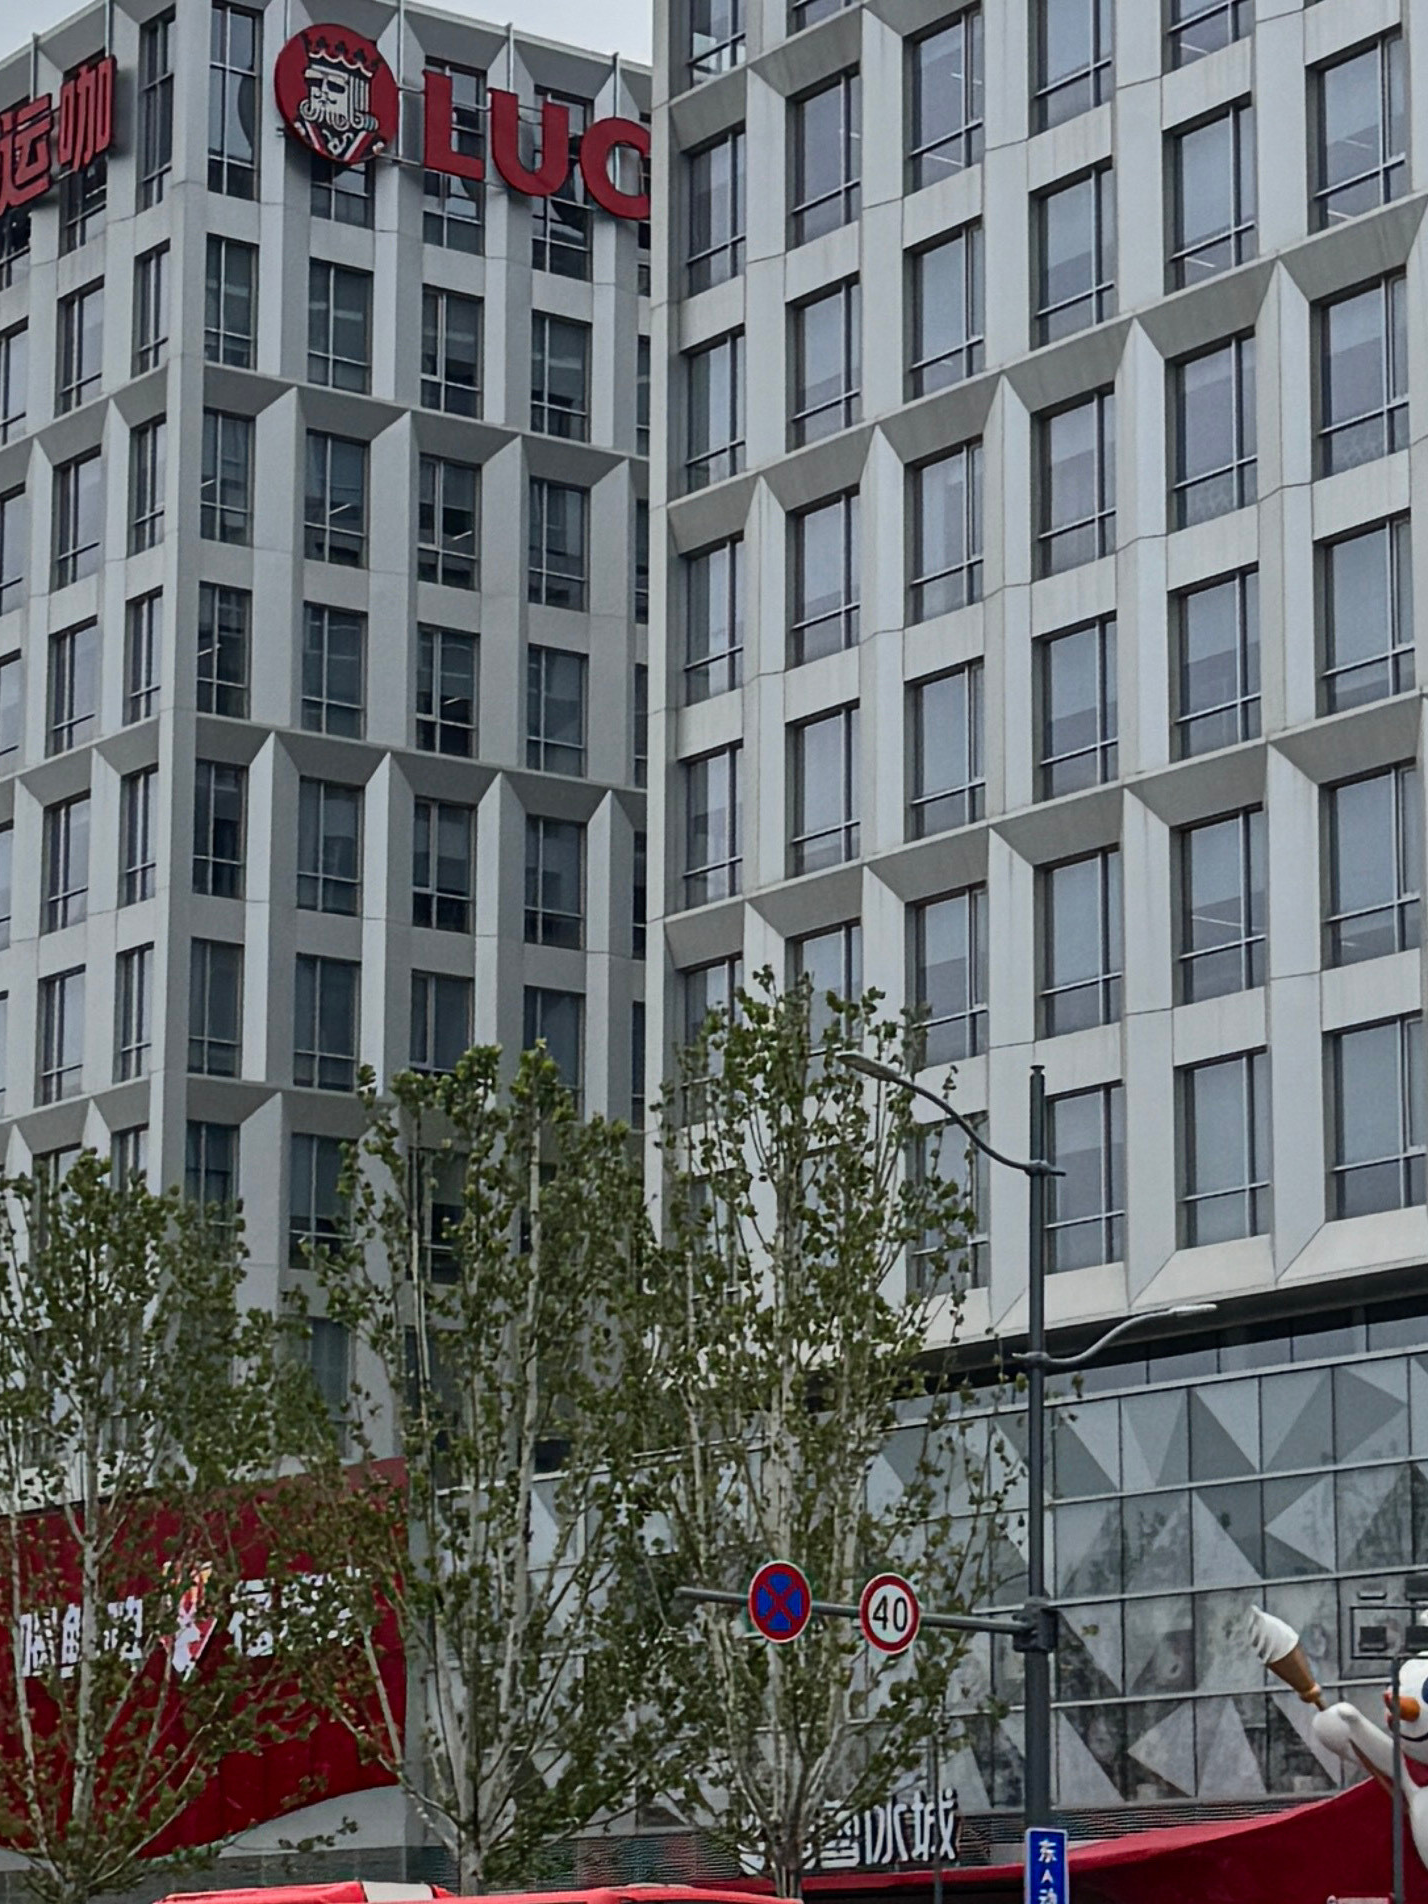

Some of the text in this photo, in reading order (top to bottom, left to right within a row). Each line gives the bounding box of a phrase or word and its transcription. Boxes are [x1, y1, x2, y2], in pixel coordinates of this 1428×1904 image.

[872, 1595, 908, 1633] 40
[774, 1788, 957, 1869] 雪冰城
